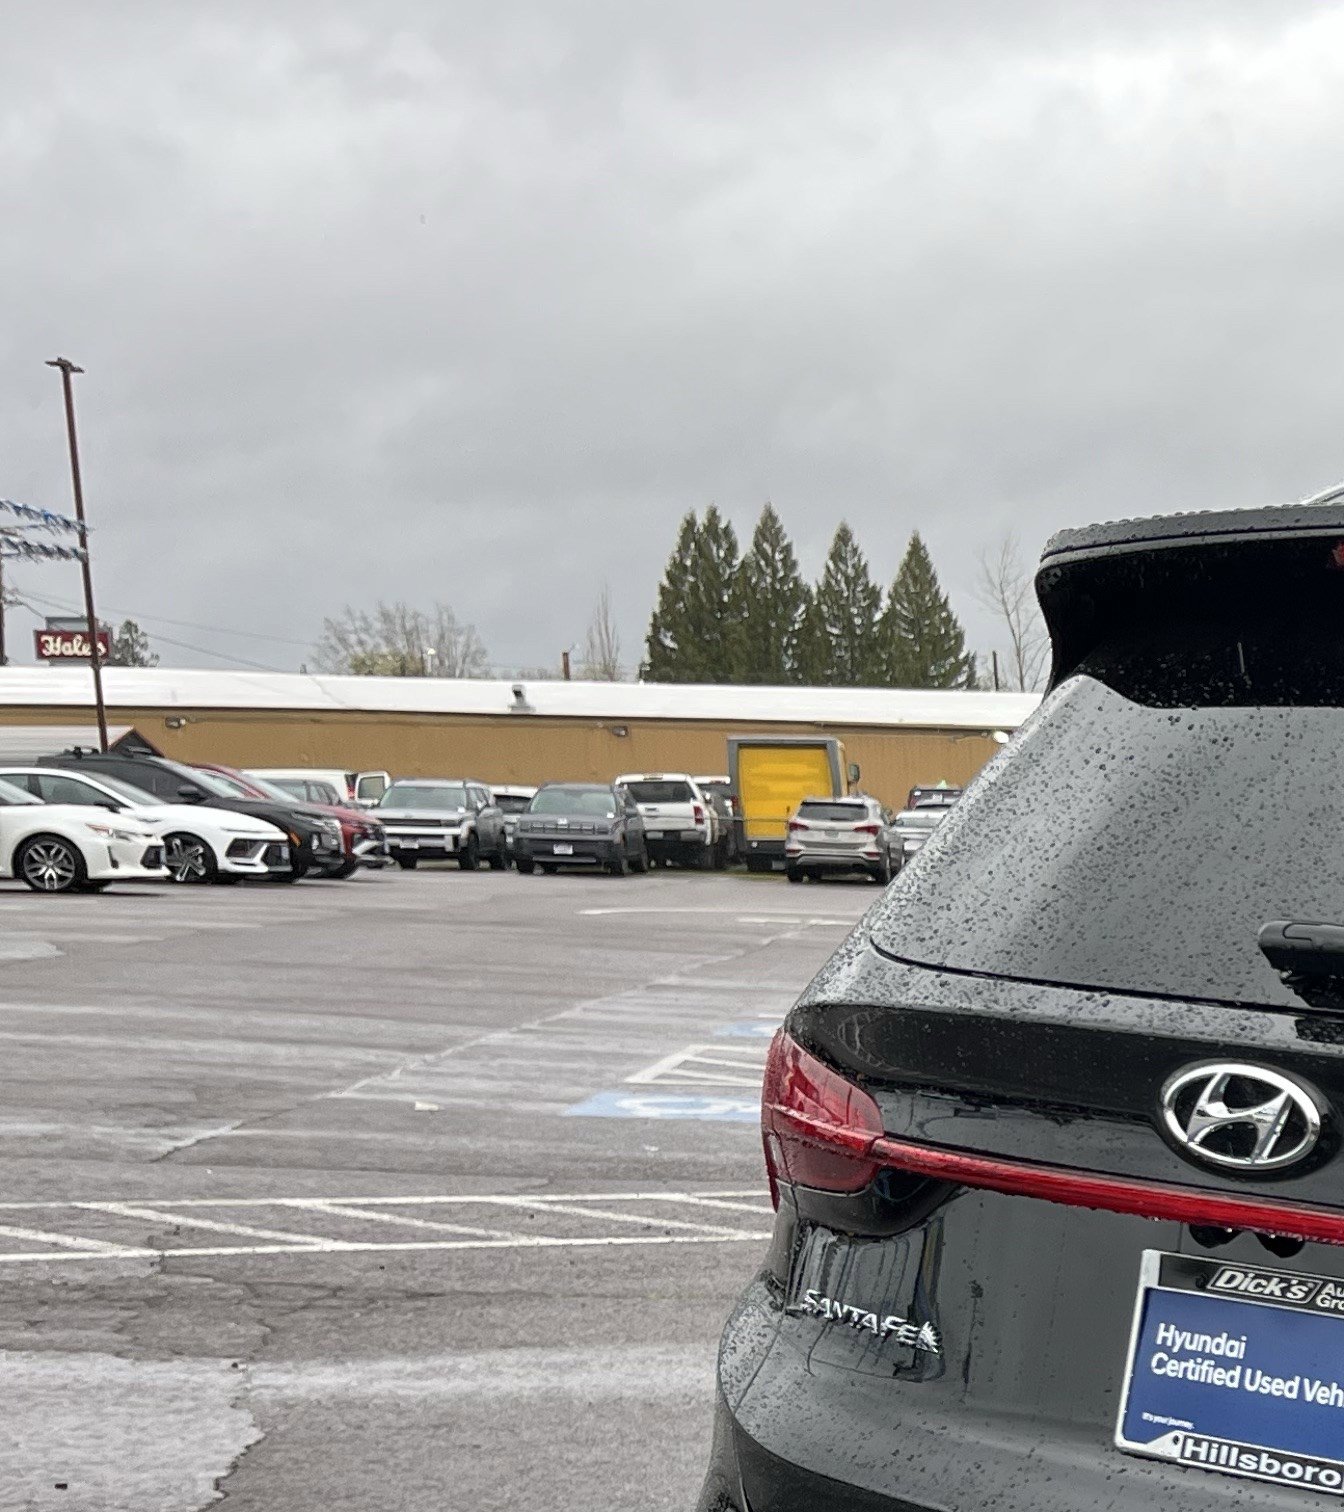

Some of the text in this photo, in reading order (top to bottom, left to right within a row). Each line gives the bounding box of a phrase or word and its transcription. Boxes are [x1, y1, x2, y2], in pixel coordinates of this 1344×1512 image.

[1215, 1270, 1309, 1300] Dick's
[1156, 1322, 1248, 1360] Hyundai
[1151, 1352, 1242, 1388] Certified
[1244, 1369, 1300, 1400] Used
[1184, 1438, 1341, 1487] Hillsboro
